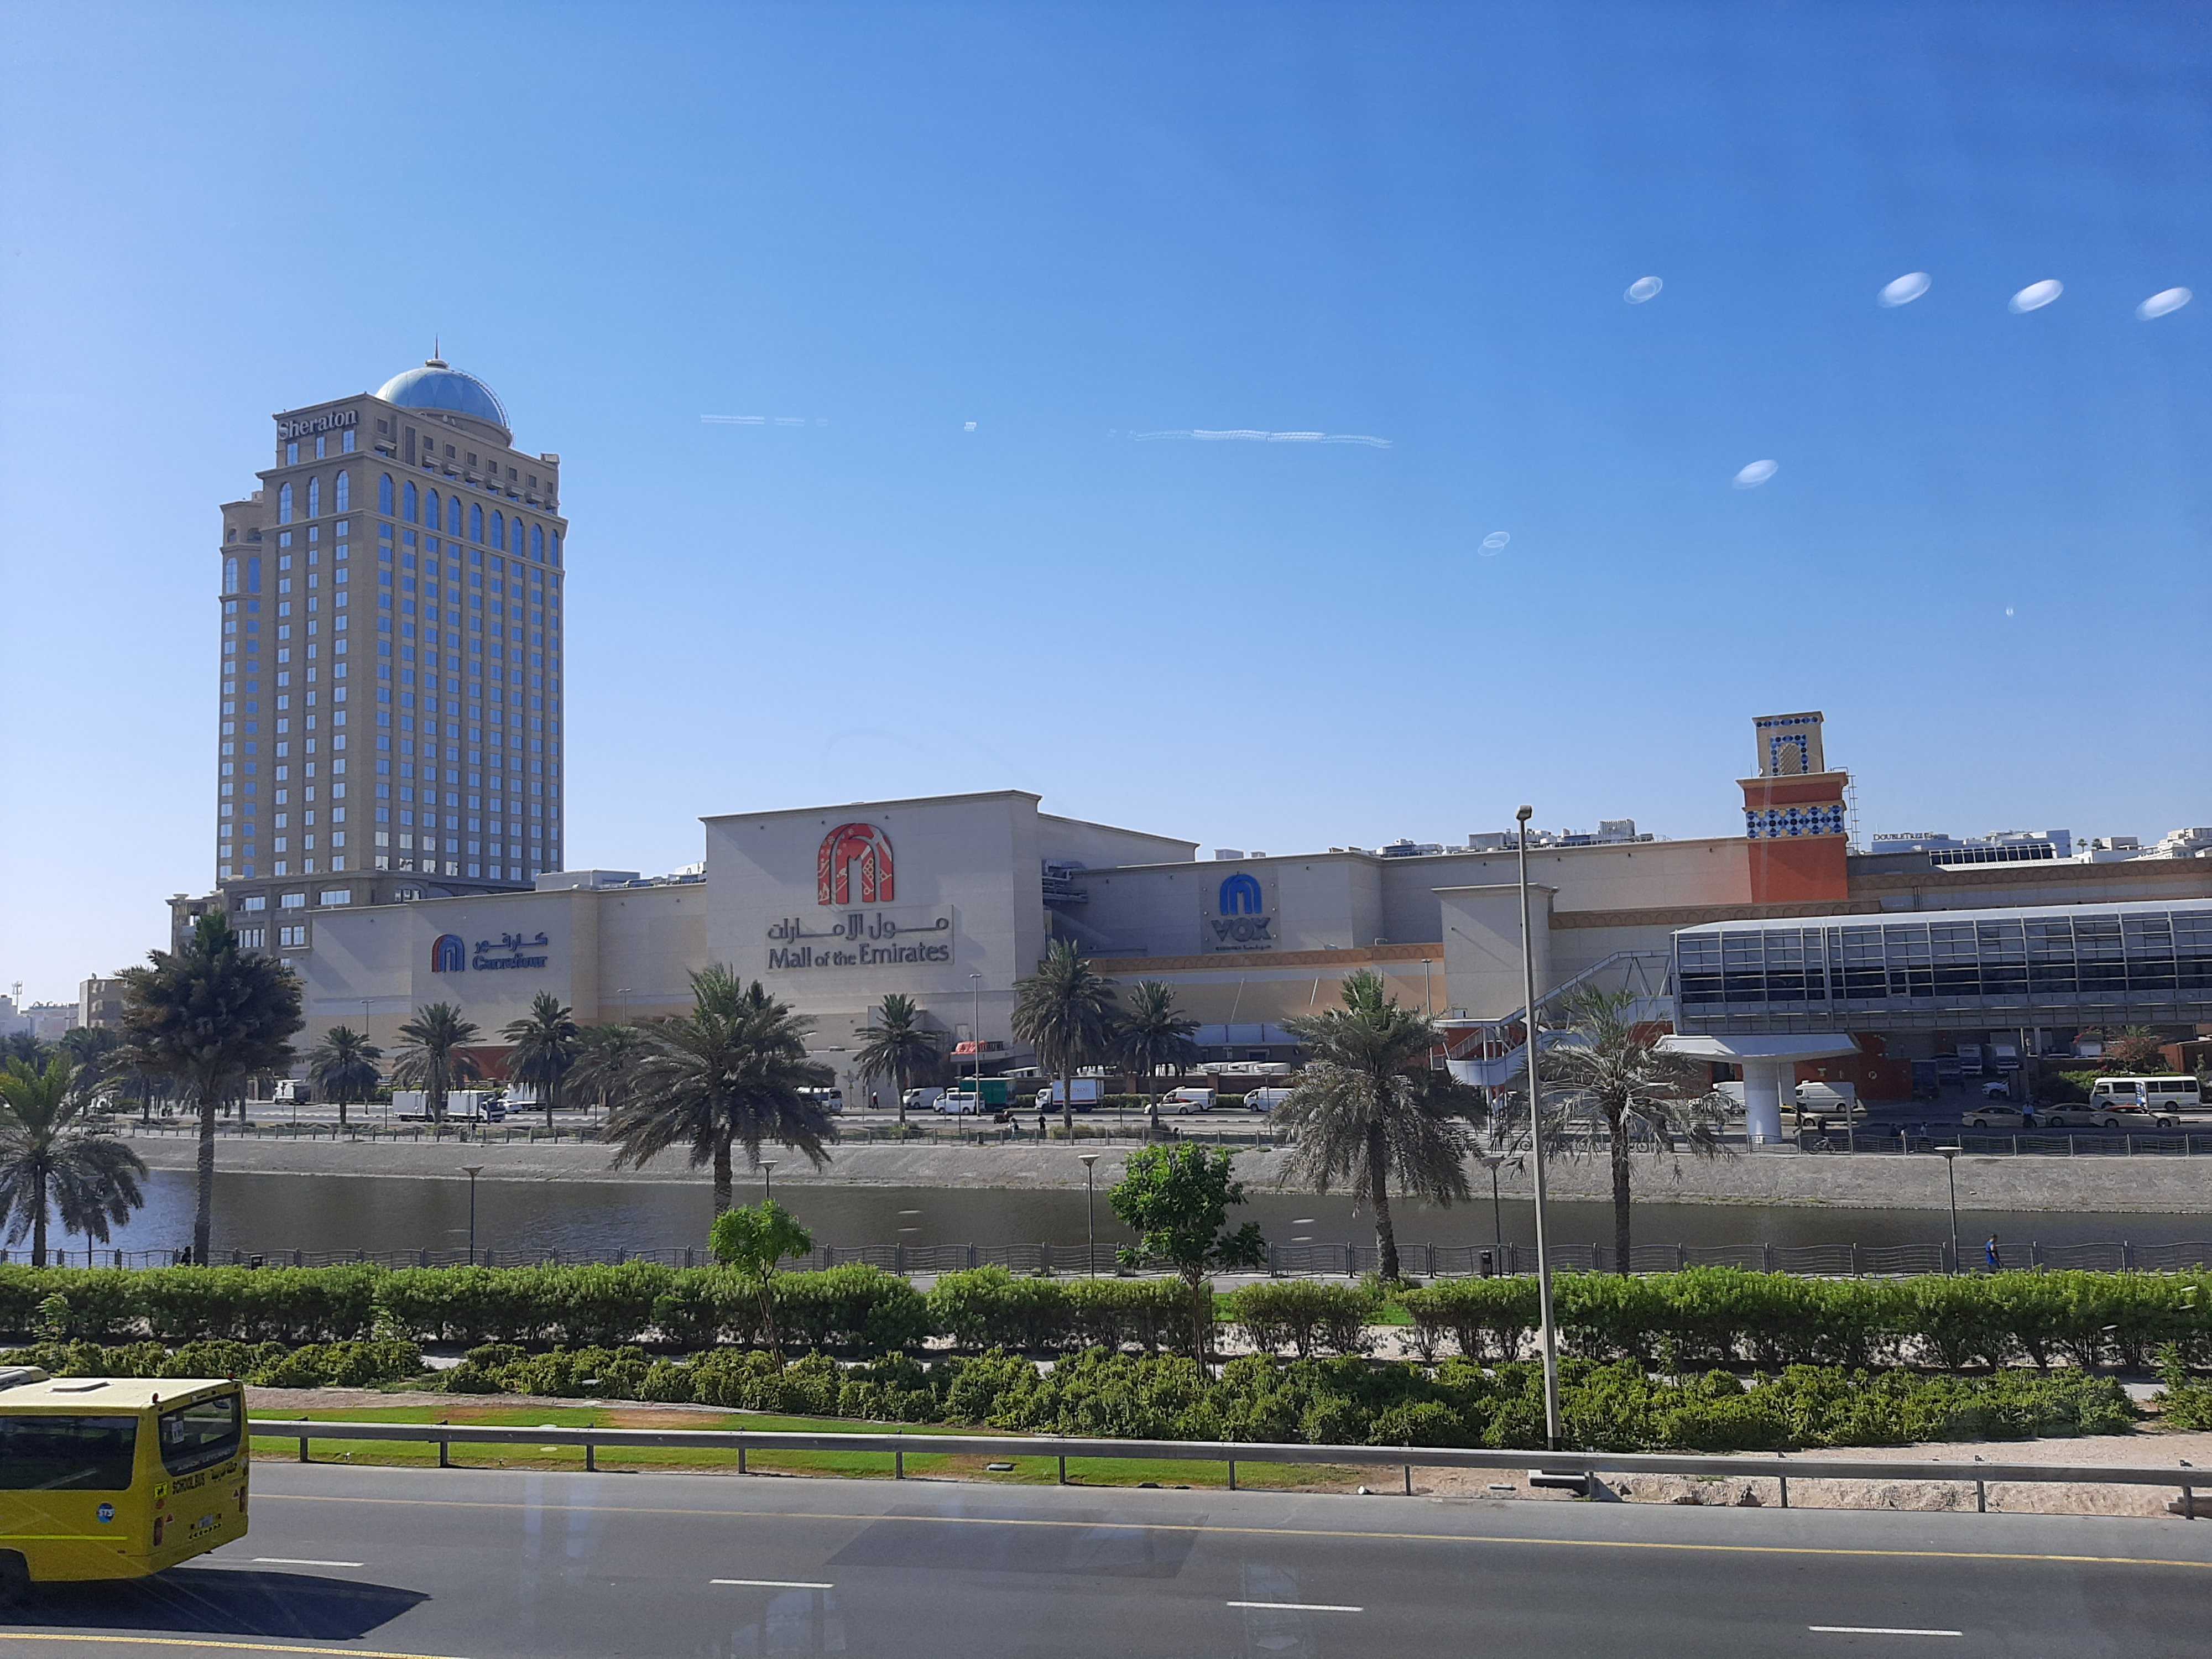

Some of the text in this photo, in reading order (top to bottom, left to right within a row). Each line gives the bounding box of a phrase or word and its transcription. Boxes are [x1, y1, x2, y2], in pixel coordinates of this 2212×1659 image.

[278, 410, 357, 440] Sheraton
[868, 912, 949, 940] مول
[1211, 917, 1271, 942] VOX
[474, 932, 548, 953] كارفور
[768, 942, 949, 969] Mall of the Emirates
[473, 953, 548, 971] Carrefour
